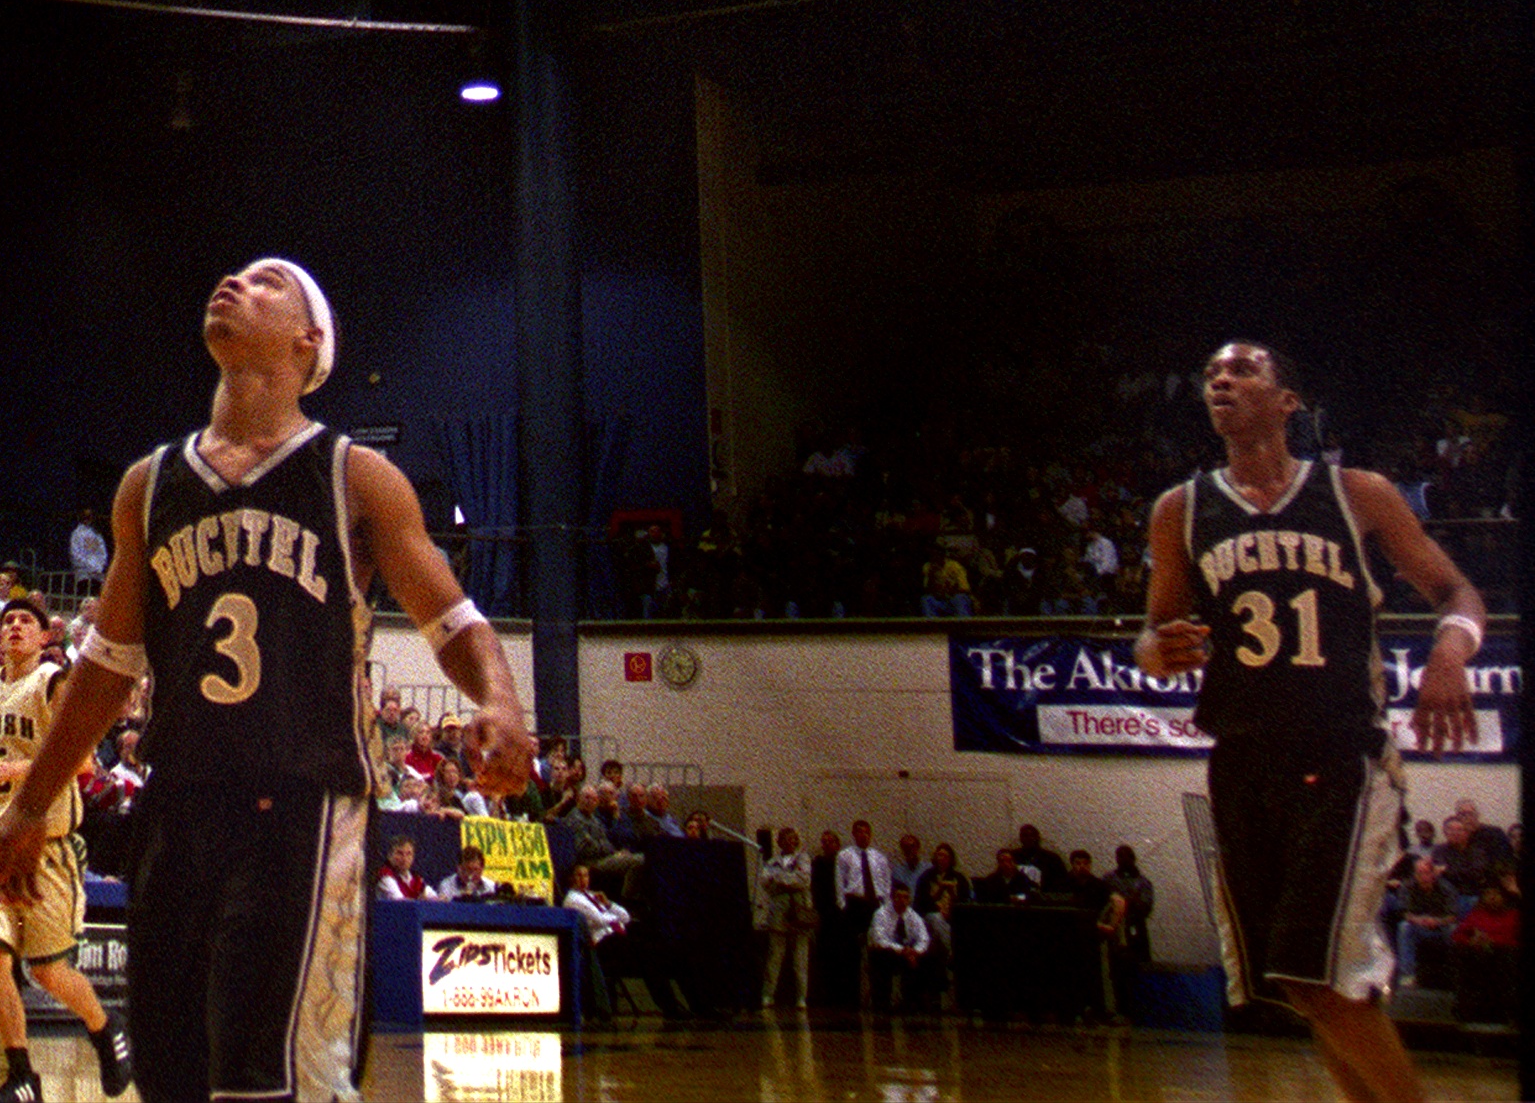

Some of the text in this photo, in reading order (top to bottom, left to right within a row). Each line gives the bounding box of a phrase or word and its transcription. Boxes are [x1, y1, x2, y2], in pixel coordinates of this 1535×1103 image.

[200, 592, 262, 705] 3
[1230, 589, 1327, 668] 31
[967, 648, 1057, 691] The
[1066, 710, 1160, 736] There's
[515, 859, 551, 879] AM
